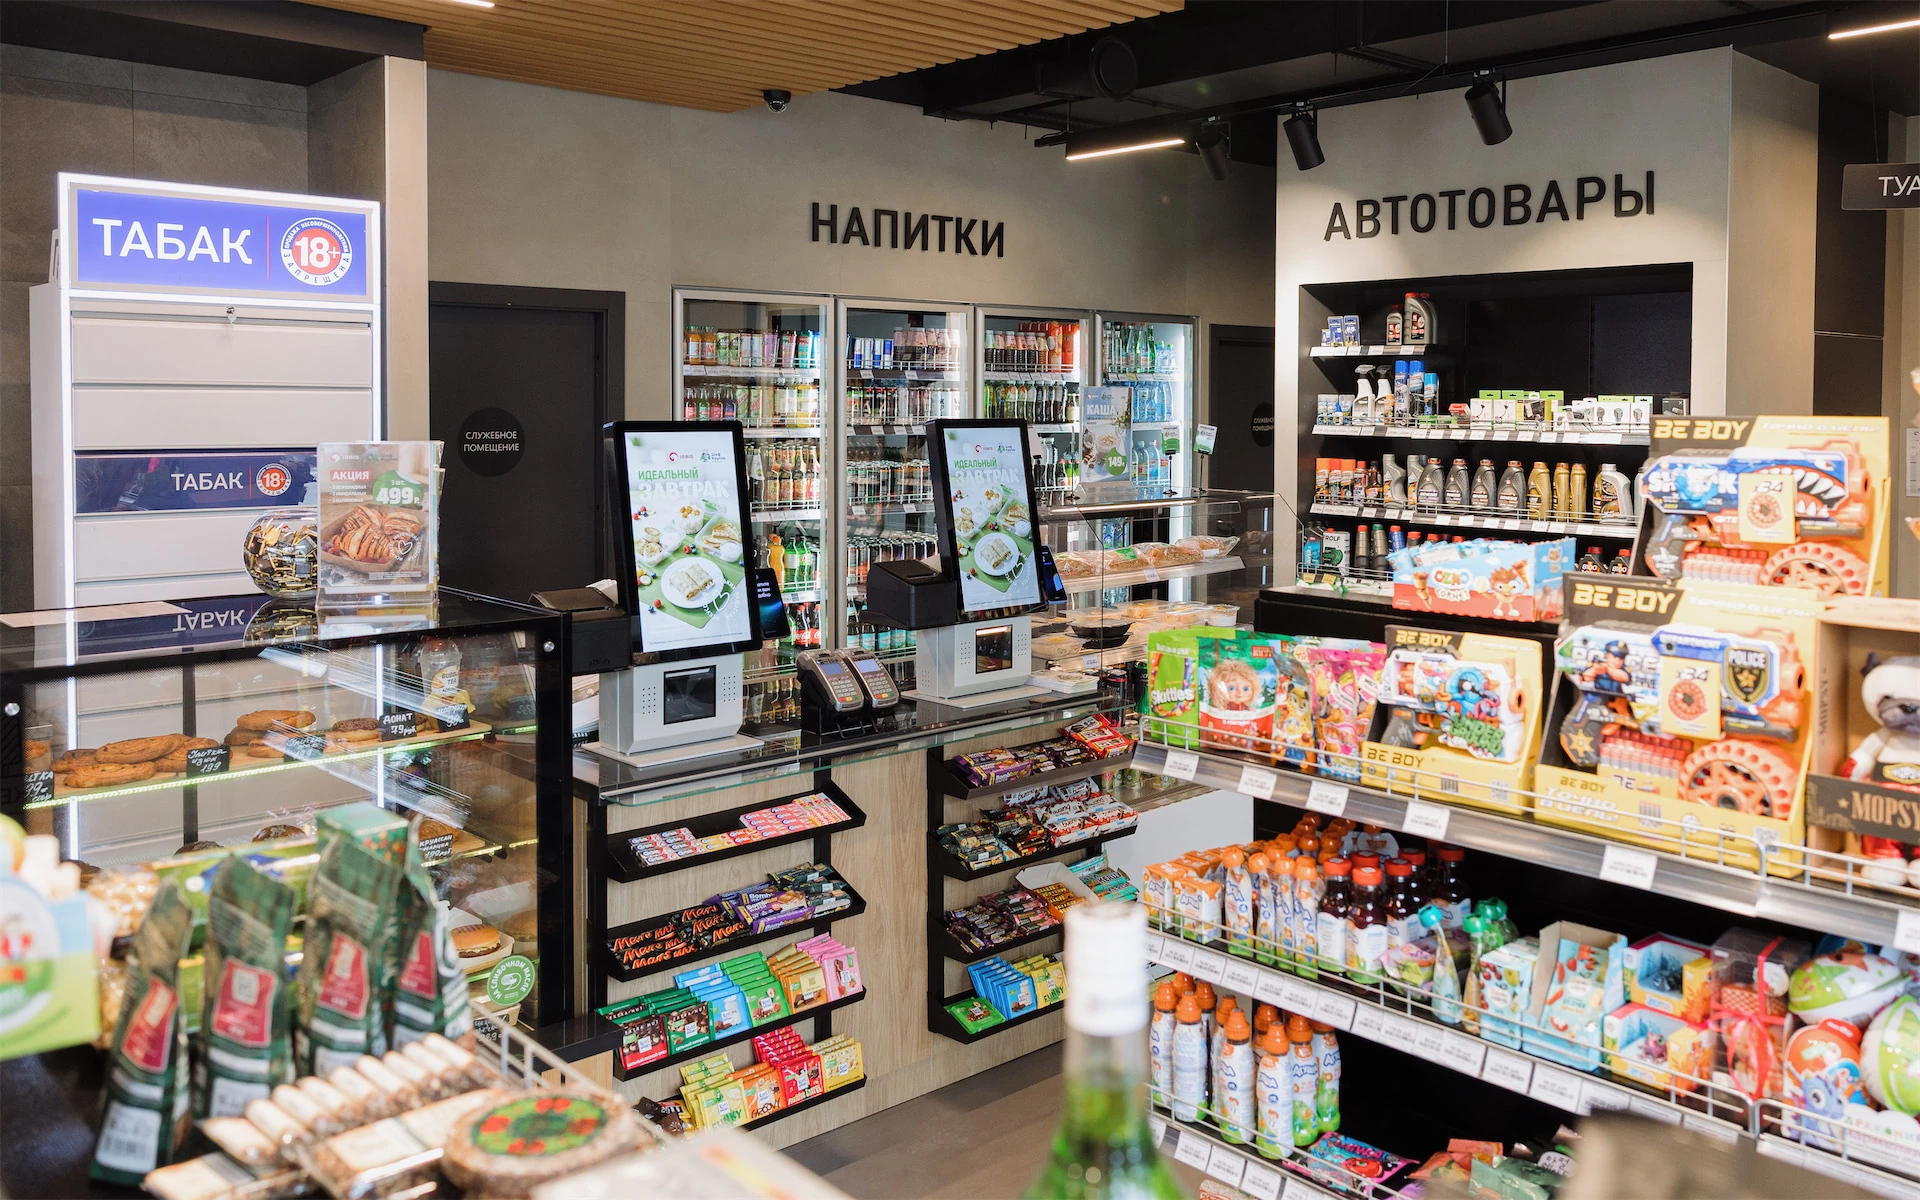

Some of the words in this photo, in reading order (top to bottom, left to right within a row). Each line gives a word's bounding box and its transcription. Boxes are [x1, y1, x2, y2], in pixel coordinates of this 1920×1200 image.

[1323, 170, 1655, 242] АВТОТОВАРЫ
[811, 202, 1005, 258] НАПИТКИ
[92, 217, 252, 265] ТАБАК
[294, 236, 341, 269] 18+
[283, 253, 350, 284] ЗАПРЕЩЕНА
[1086, 404, 1116, 415] КАША
[465, 431, 518, 440] СЛУЖЕБНОЕ
[1653, 419, 1692, 439] BE
[1692, 420, 1750, 441] BOY
[463, 443, 520, 453] ПОМЕЩЕНИЕ
[954, 457, 997, 469] ИДЕАЛЬНЫЙ
[171, 472, 243, 491] ТАБАК
[263, 472, 286, 488] 18+
[332, 470, 370, 481] АКЦИЯ
[638, 467, 699, 480] ИДЕАЛЬНЫЙ
[954, 468, 1020, 485] ЗАВТРАК
[376, 487, 414, 504] 499
[638, 480, 730, 500] ЗАВТРАК
[1573, 583, 1614, 608] BE
[1615, 586, 1679, 614] BOY
[1396, 630, 1418, 645] BE
[1419, 632, 1453, 647] BOY
[1728, 650, 1767, 668] POLICE
[1150, 687, 1195, 706] Skittles
[383, 712, 413, 724] ДОНАТ
[1367, 747, 1388, 763] BE
[1392, 751, 1425, 768] BOY
[1560, 775, 1579, 788] BE
[1580, 780, 1608, 793] BOY
[419, 834, 453, 848] КРУАССАН
[681, 904, 719, 922] Mars
[692, 913, 726, 935] Mars
[712, 922, 746, 942] Mars
[613, 930, 653, 953] Mars
[655, 923, 676, 939] MAX
[623, 941, 664, 963] Mars
[632, 950, 671, 969] Mars
[673, 944, 698, 958] MAX
[491, 960, 525, 990] СЛИВОЧНОМ
[520, 965, 531, 993] МАСЛЕ
[493, 988, 503, 1000] НА
[751, 1099, 782, 1119] GROOVY
